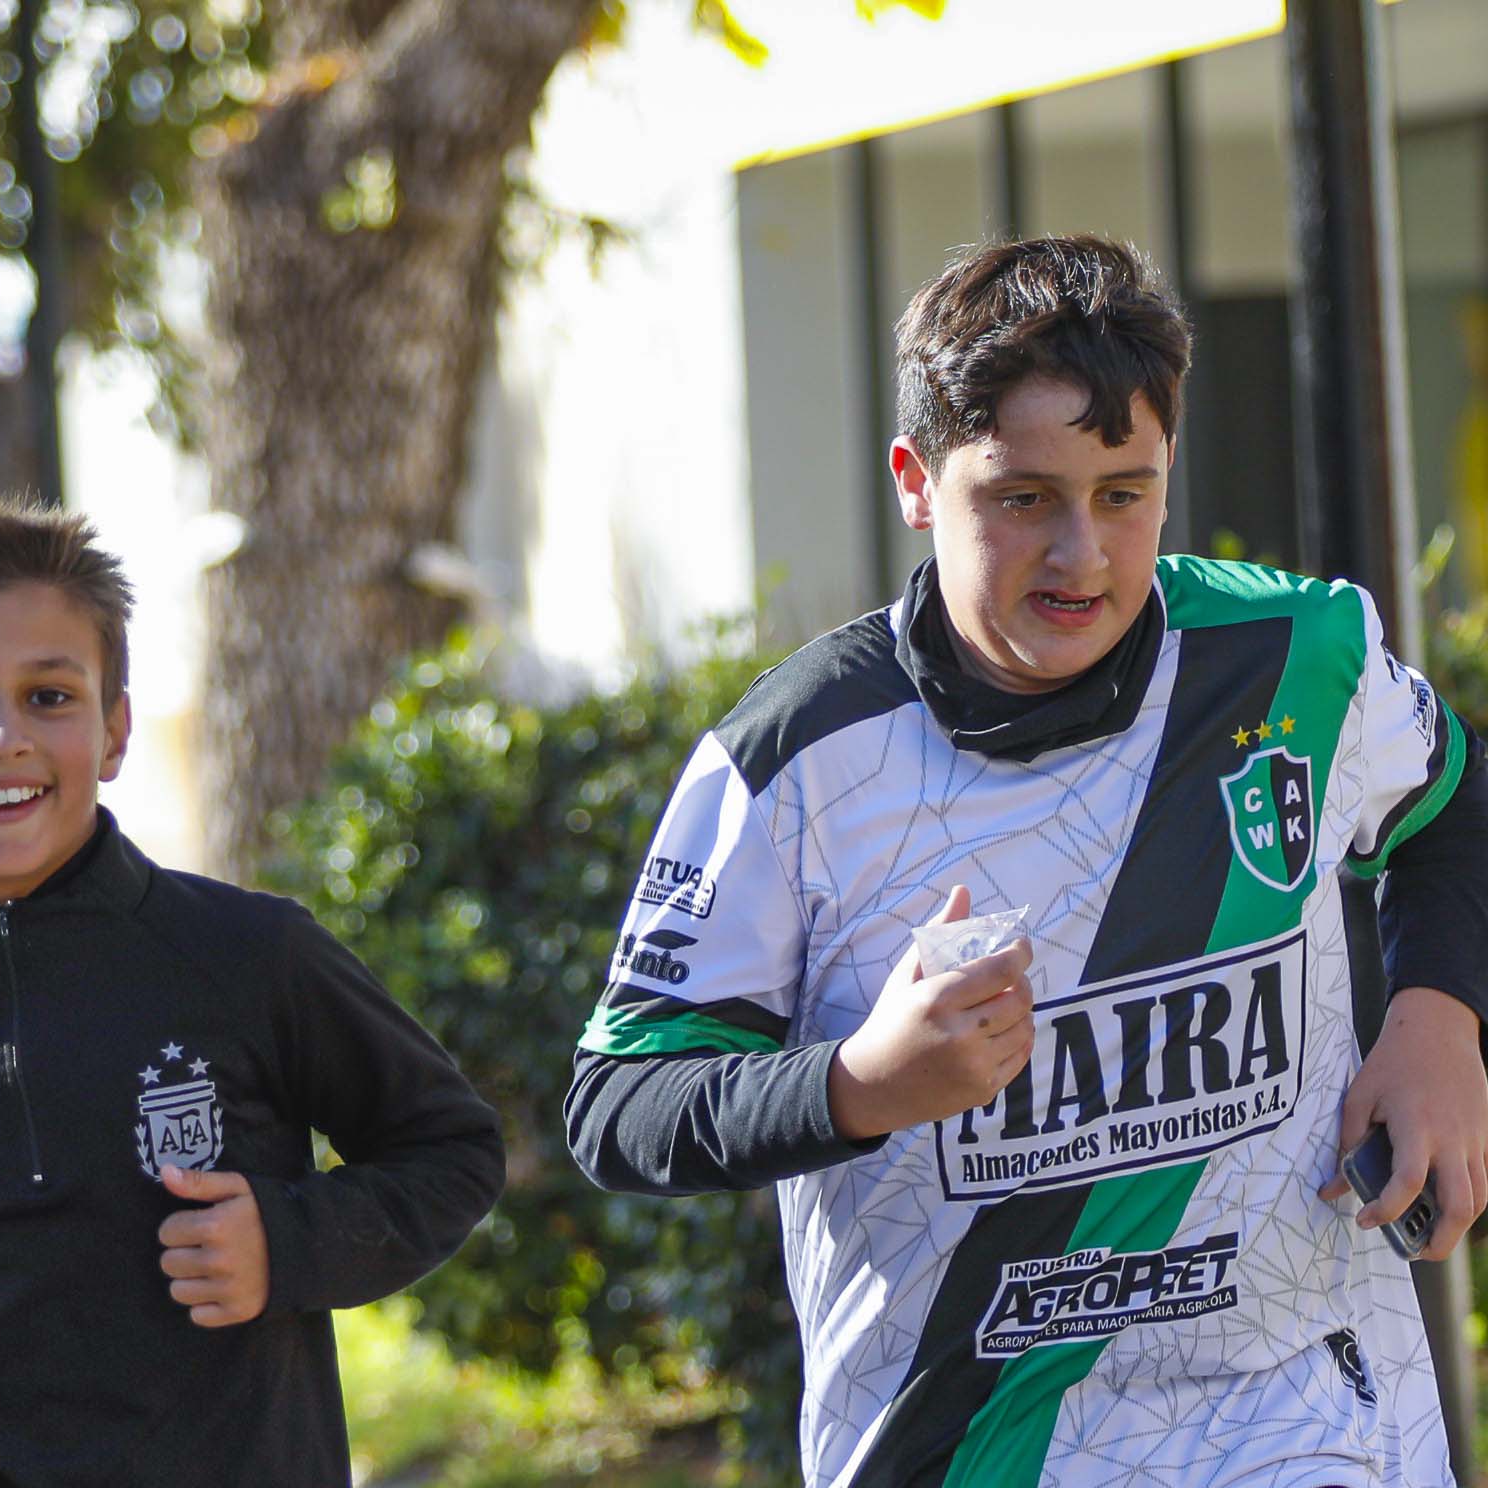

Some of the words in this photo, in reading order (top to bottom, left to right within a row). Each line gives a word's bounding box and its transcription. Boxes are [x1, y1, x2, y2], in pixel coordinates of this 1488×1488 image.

[1244, 787, 1263, 813] C
[1284, 779, 1302, 806] A
[1247, 822, 1274, 850] W
[1286, 815, 1305, 842] K
[158, 1108, 209, 1155] AFA
[962, 1132, 1100, 1184] Almacenes
[1108, 1098, 1248, 1157] Mayoristas
[1251, 1084, 1288, 1121] S.A.
[1008, 1251, 1104, 1279] INDUSTRIA
[1062, 1320, 1094, 1335] PARA
